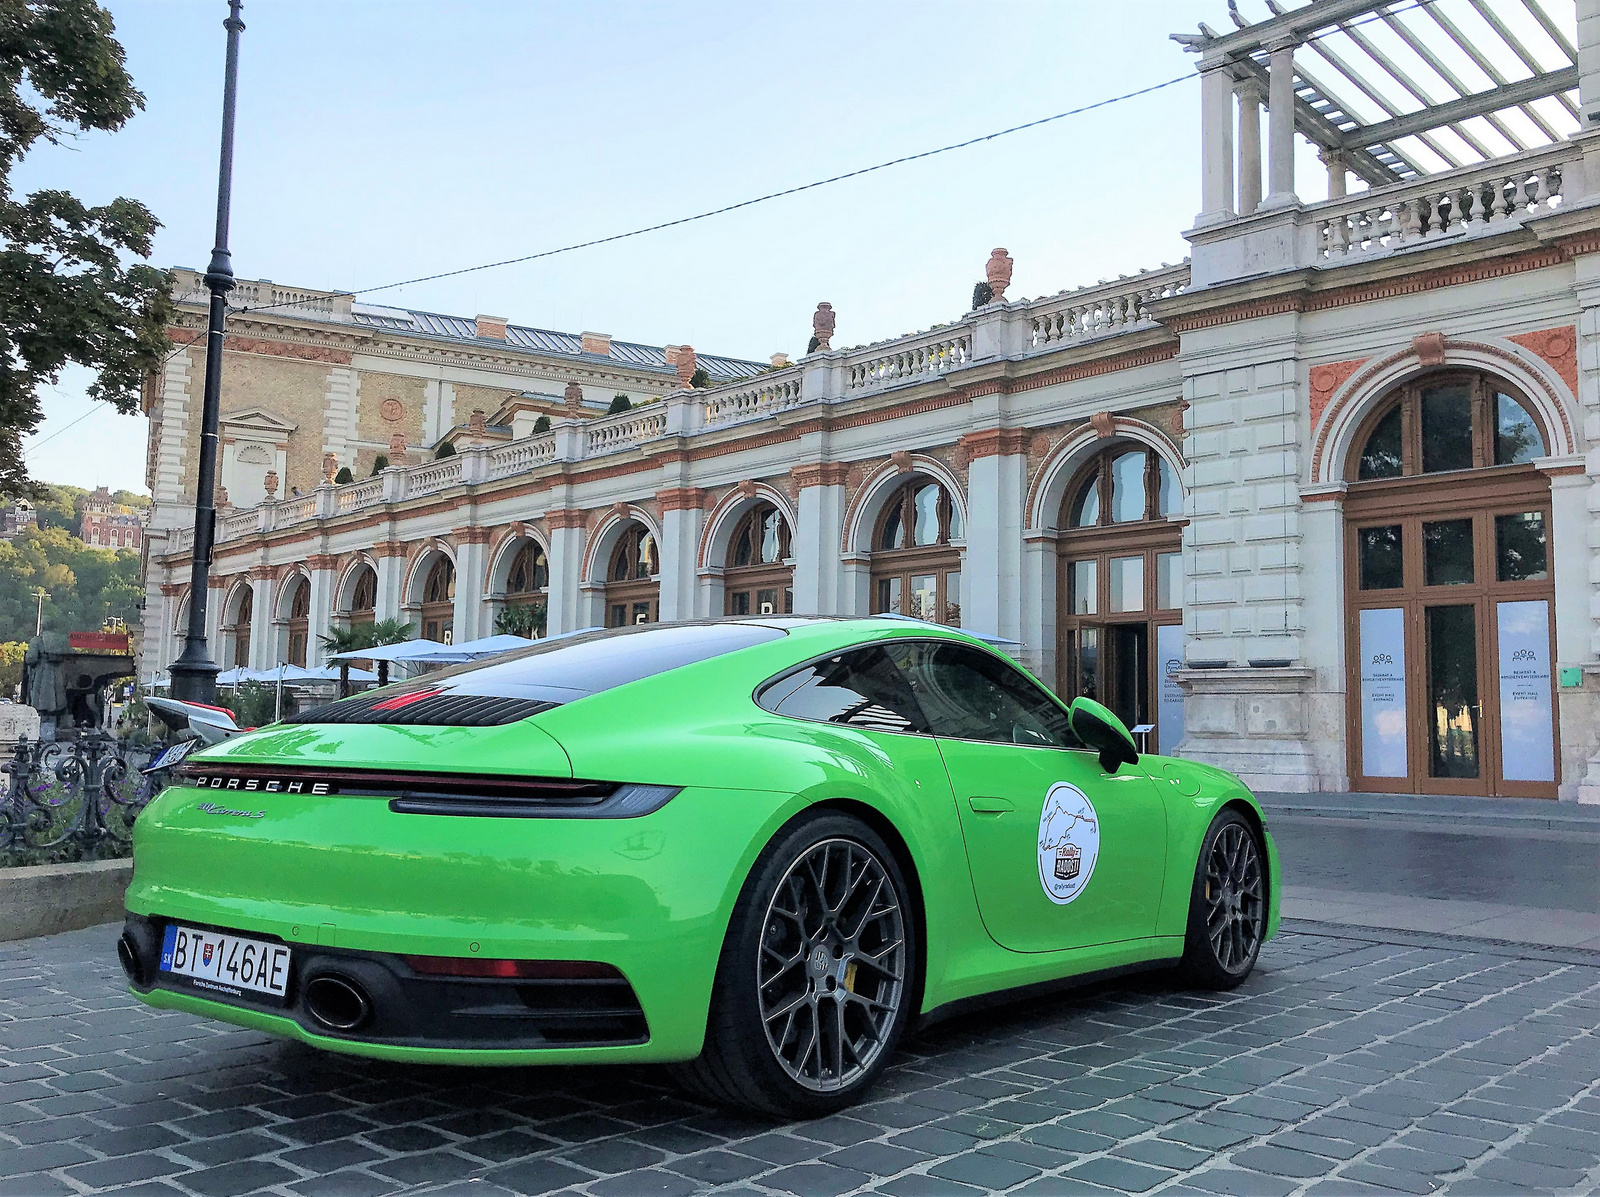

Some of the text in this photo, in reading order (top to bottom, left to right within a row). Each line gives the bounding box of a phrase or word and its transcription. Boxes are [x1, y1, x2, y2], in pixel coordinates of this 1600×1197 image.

[196, 776, 329, 795] PORSCHE
[1057, 859, 1079, 872] RADOSTI
[174, 931, 288, 991] BT 146AE
